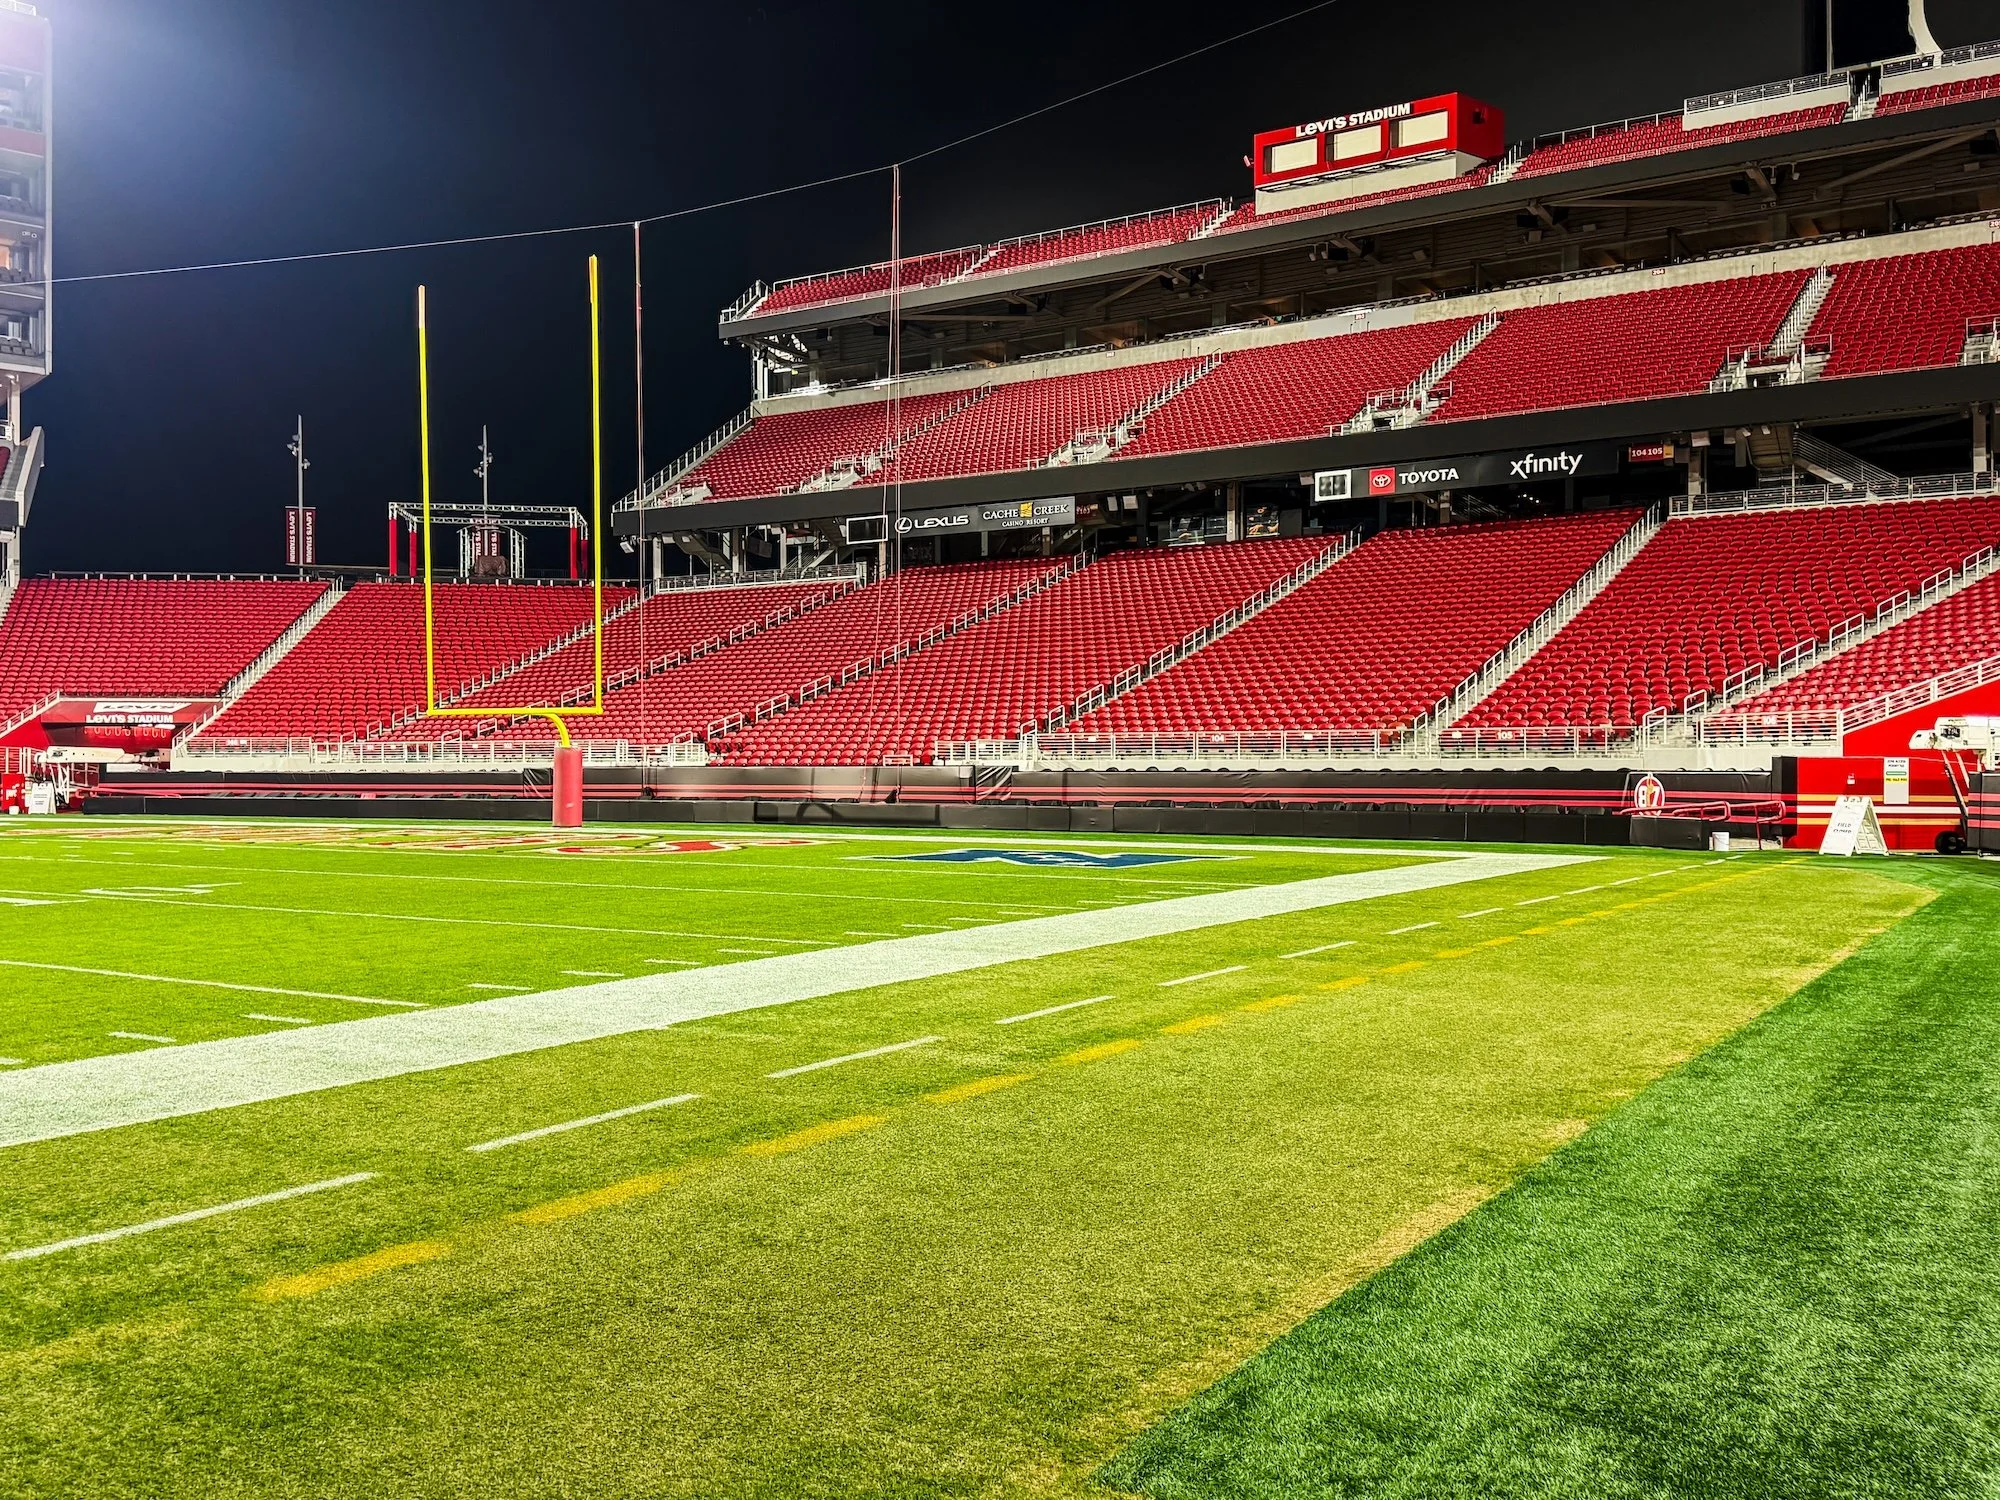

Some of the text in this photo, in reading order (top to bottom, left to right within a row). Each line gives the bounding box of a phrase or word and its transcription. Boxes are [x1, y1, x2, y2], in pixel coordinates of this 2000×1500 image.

[1349, 103, 1411, 126] STADIUM
[1632, 447, 1663, 457] 104 105
[1510, 451, 1583, 479] xfinity
[1399, 468, 1459, 485] TOYOTA
[983, 509, 1019, 520] CACHE
[1033, 504, 1069, 515] CREEK
[914, 515, 969, 529] LEXUS
[1027, 518, 1048, 526] RESORT
[127, 714, 174, 723] STADIUM
[1638, 785, 1661, 807] 87
